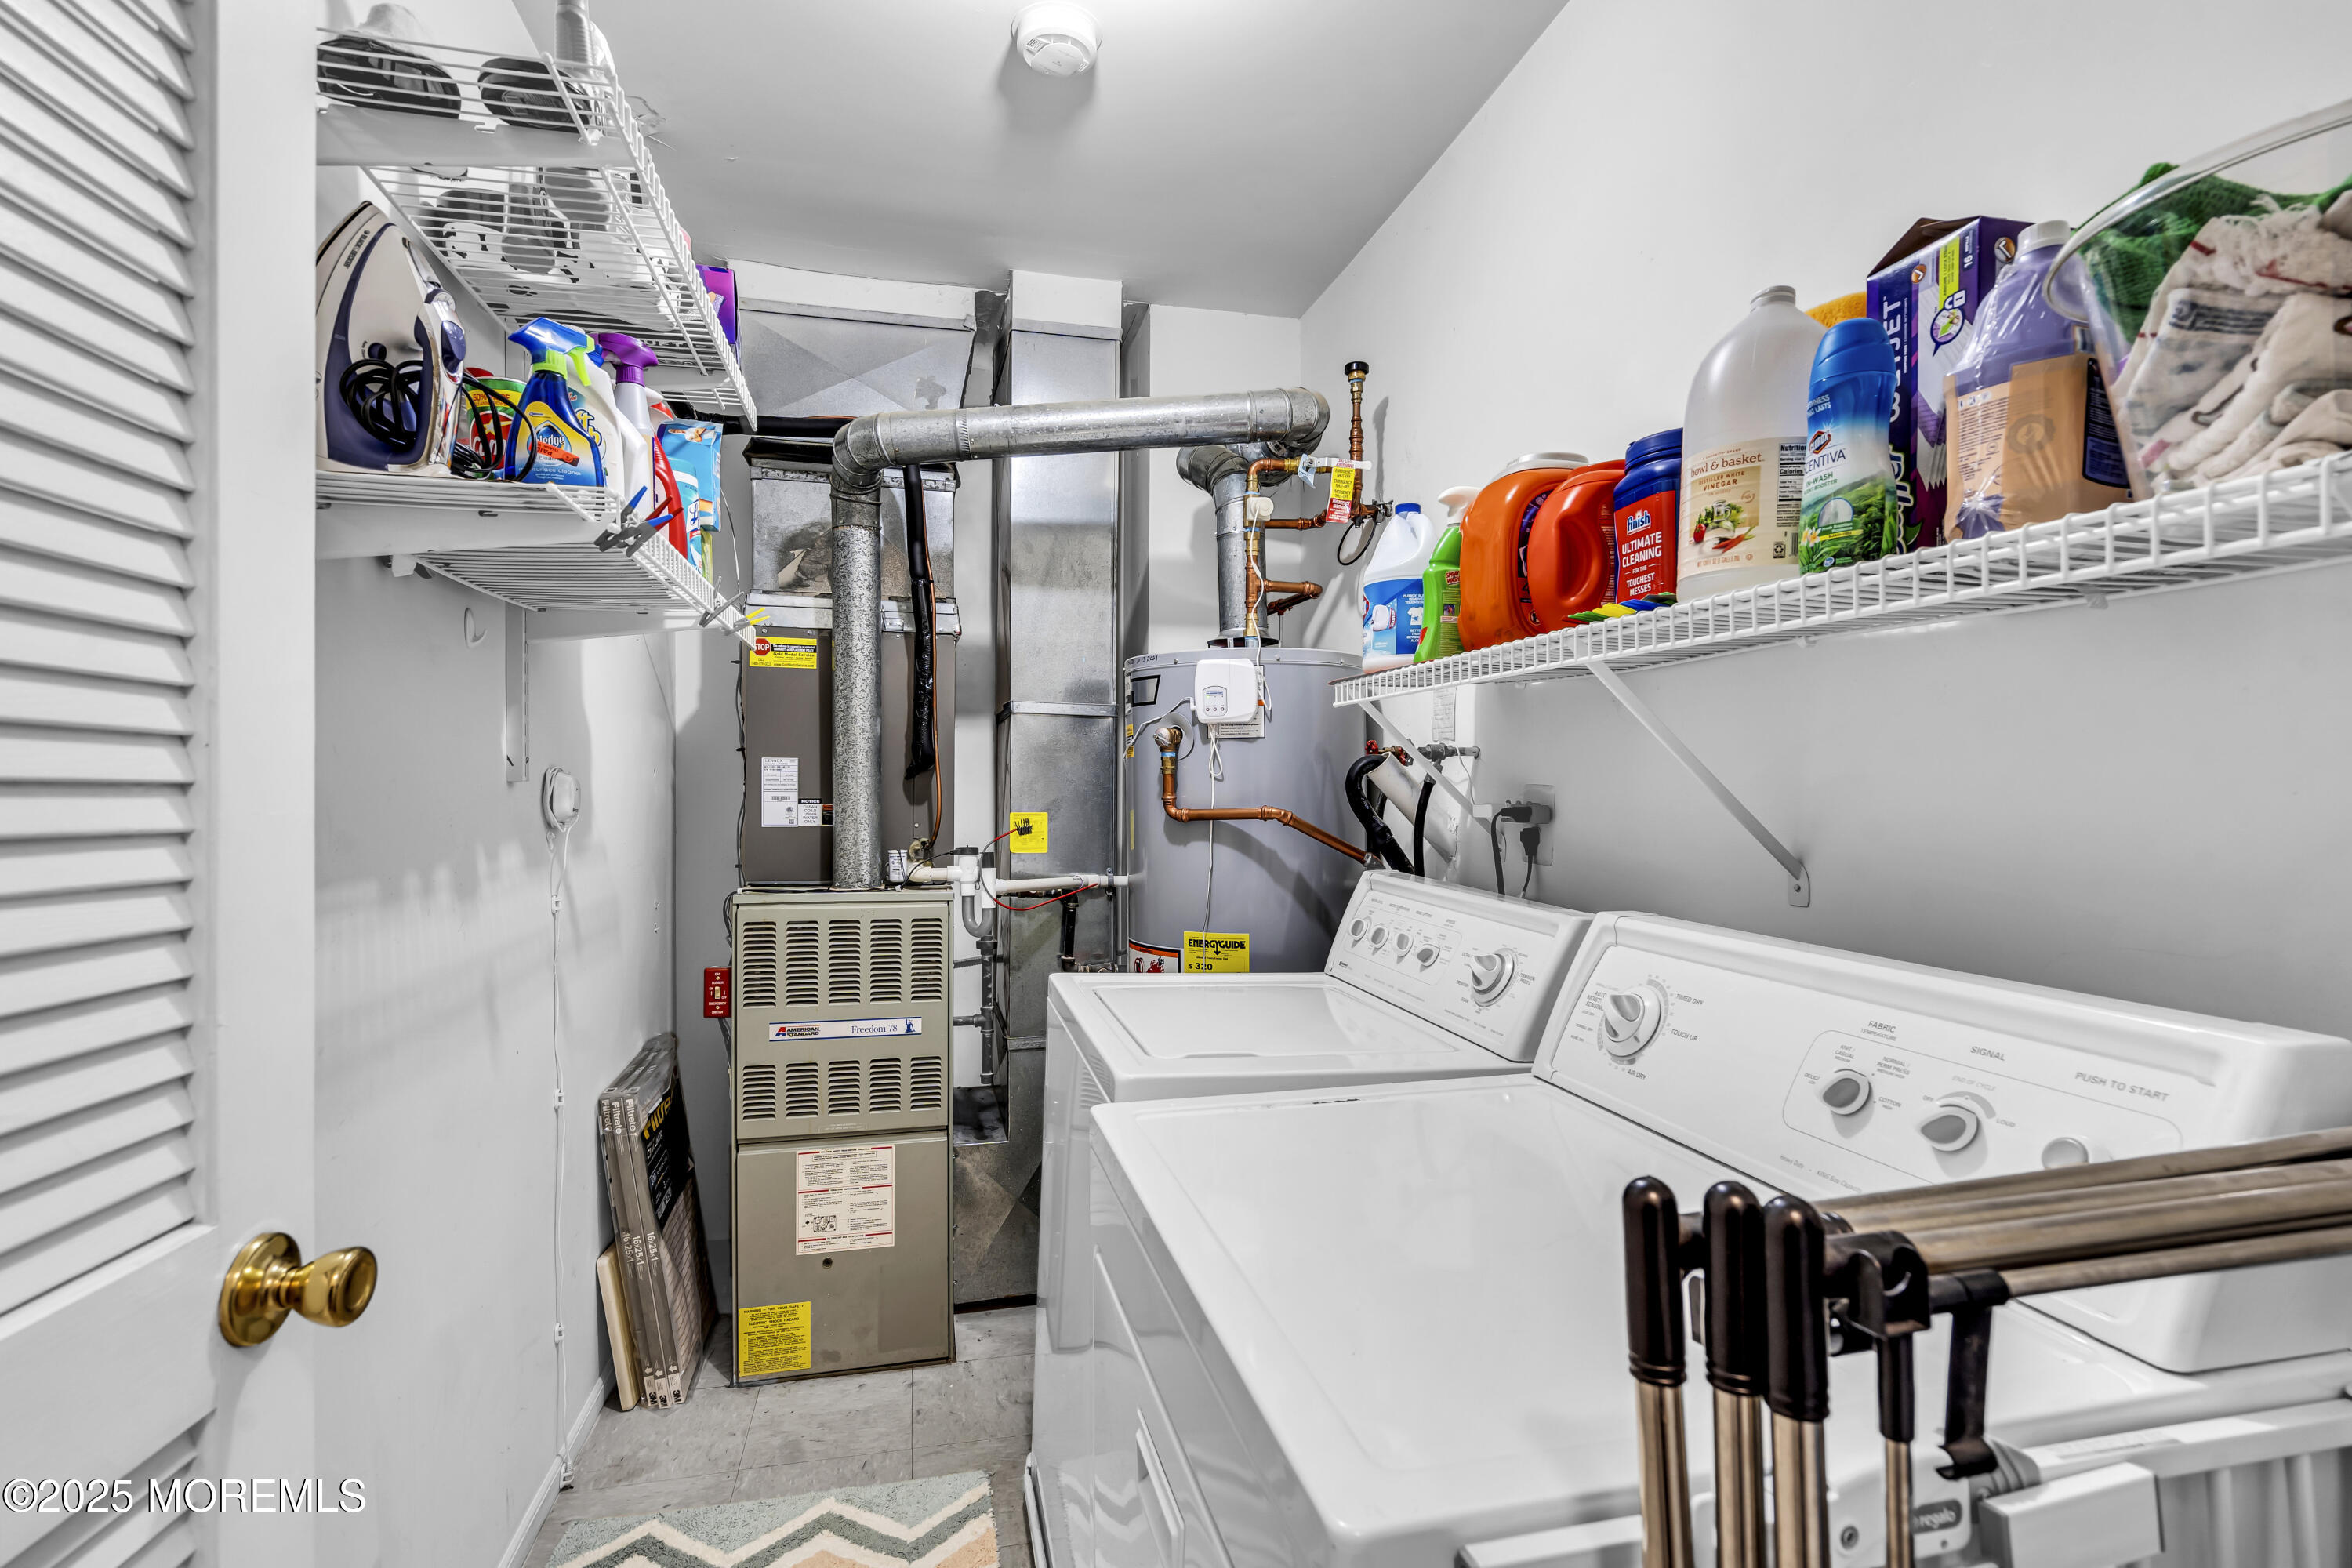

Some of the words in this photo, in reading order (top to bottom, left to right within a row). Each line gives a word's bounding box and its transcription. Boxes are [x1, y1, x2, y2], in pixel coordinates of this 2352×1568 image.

[1964, 255, 1973, 269] 16
[1814, 401, 1831, 413] LASTS
[539, 434, 564, 448] ledge
[1690, 463, 1708, 477] bowl
[1711, 461, 1719, 470] &
[1722, 453, 1762, 468] basket
[1699, 474, 1724, 485] DISTILLED
[1703, 478, 1737, 491] VINEGAR
[1627, 510, 1650, 532] finish
[1622, 531, 1662, 555] ULTIMATE
[1622, 545, 1662, 568] CLEANING
[1626, 572, 1655, 588] TOUGHEST
[1629, 583, 1651, 596] MESSES
[1189, 938, 1246, 949] ENERGYGUIDE
[851, 1025, 886, 1034] Freedom
[1867, 1020, 1896, 1033] FABRIC
[1671, 1028, 1688, 1039] TOUCH
[1860, 1028, 1896, 1041] TEMPERATURE
[1835, 1050, 1855, 1060] CASUAL
[1970, 1046, 2005, 1062] SIGNAL
[1635, 1071, 1647, 1080] DRY
[1877, 1062, 1893, 1072] PERM
[1893, 1065, 1910, 1076] PRESS
[1951, 1075, 1965, 1083] END
[1976, 1081, 1997, 1092] CYCLE
[2074, 1072, 2107, 1087] PUSH
[2110, 1080, 2127, 1091] TO
[2129, 1084, 2169, 1102] START
[1878, 1096, 1902, 1109] COTTON
[1996, 1118, 2016, 1128] LOUD
[622, 1232, 634, 1262] 16x25x1
[633, 1235, 644, 1265] 16x25x1
[647, 1232, 659, 1261] 16x25x1
[649, 1392, 657, 1405] 3M
[659, 1395, 667, 1407] 3M
[673, 1389, 681, 1403] 3M
